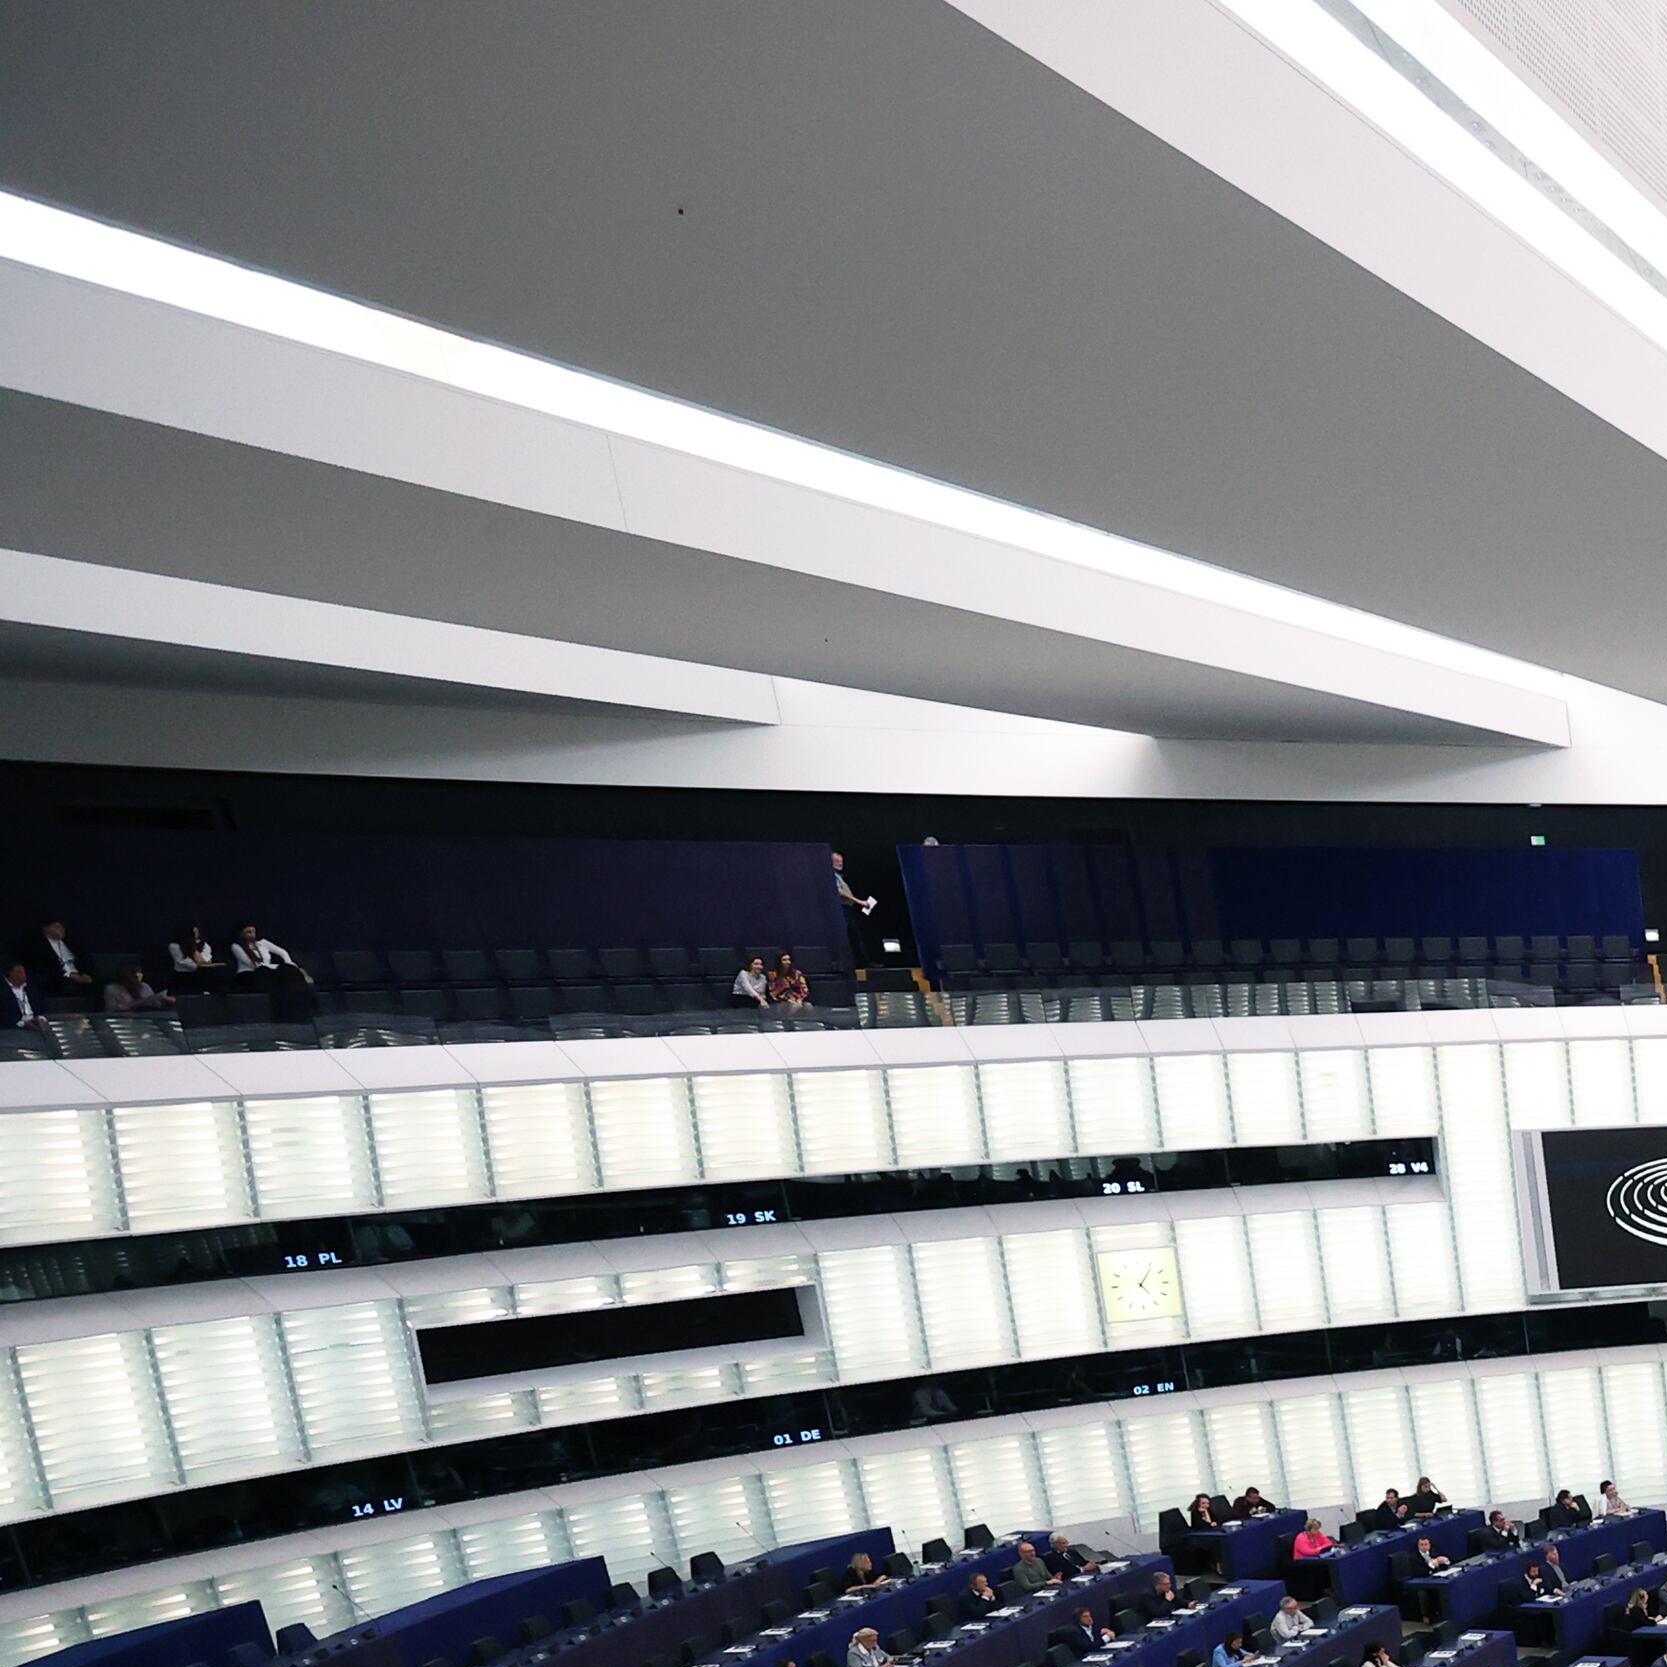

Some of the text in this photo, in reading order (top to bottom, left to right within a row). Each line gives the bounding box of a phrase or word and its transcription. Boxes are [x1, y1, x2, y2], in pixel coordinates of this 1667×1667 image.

[1102, 1181, 1145, 1195] 20 SL
[726, 1210, 777, 1225] 19 SK
[284, 1252, 343, 1268] 18 PL
[1133, 1381, 1175, 1395] 02 EN
[773, 1428, 822, 1446] 01 DE
[351, 1497, 403, 1517] 14 LV
